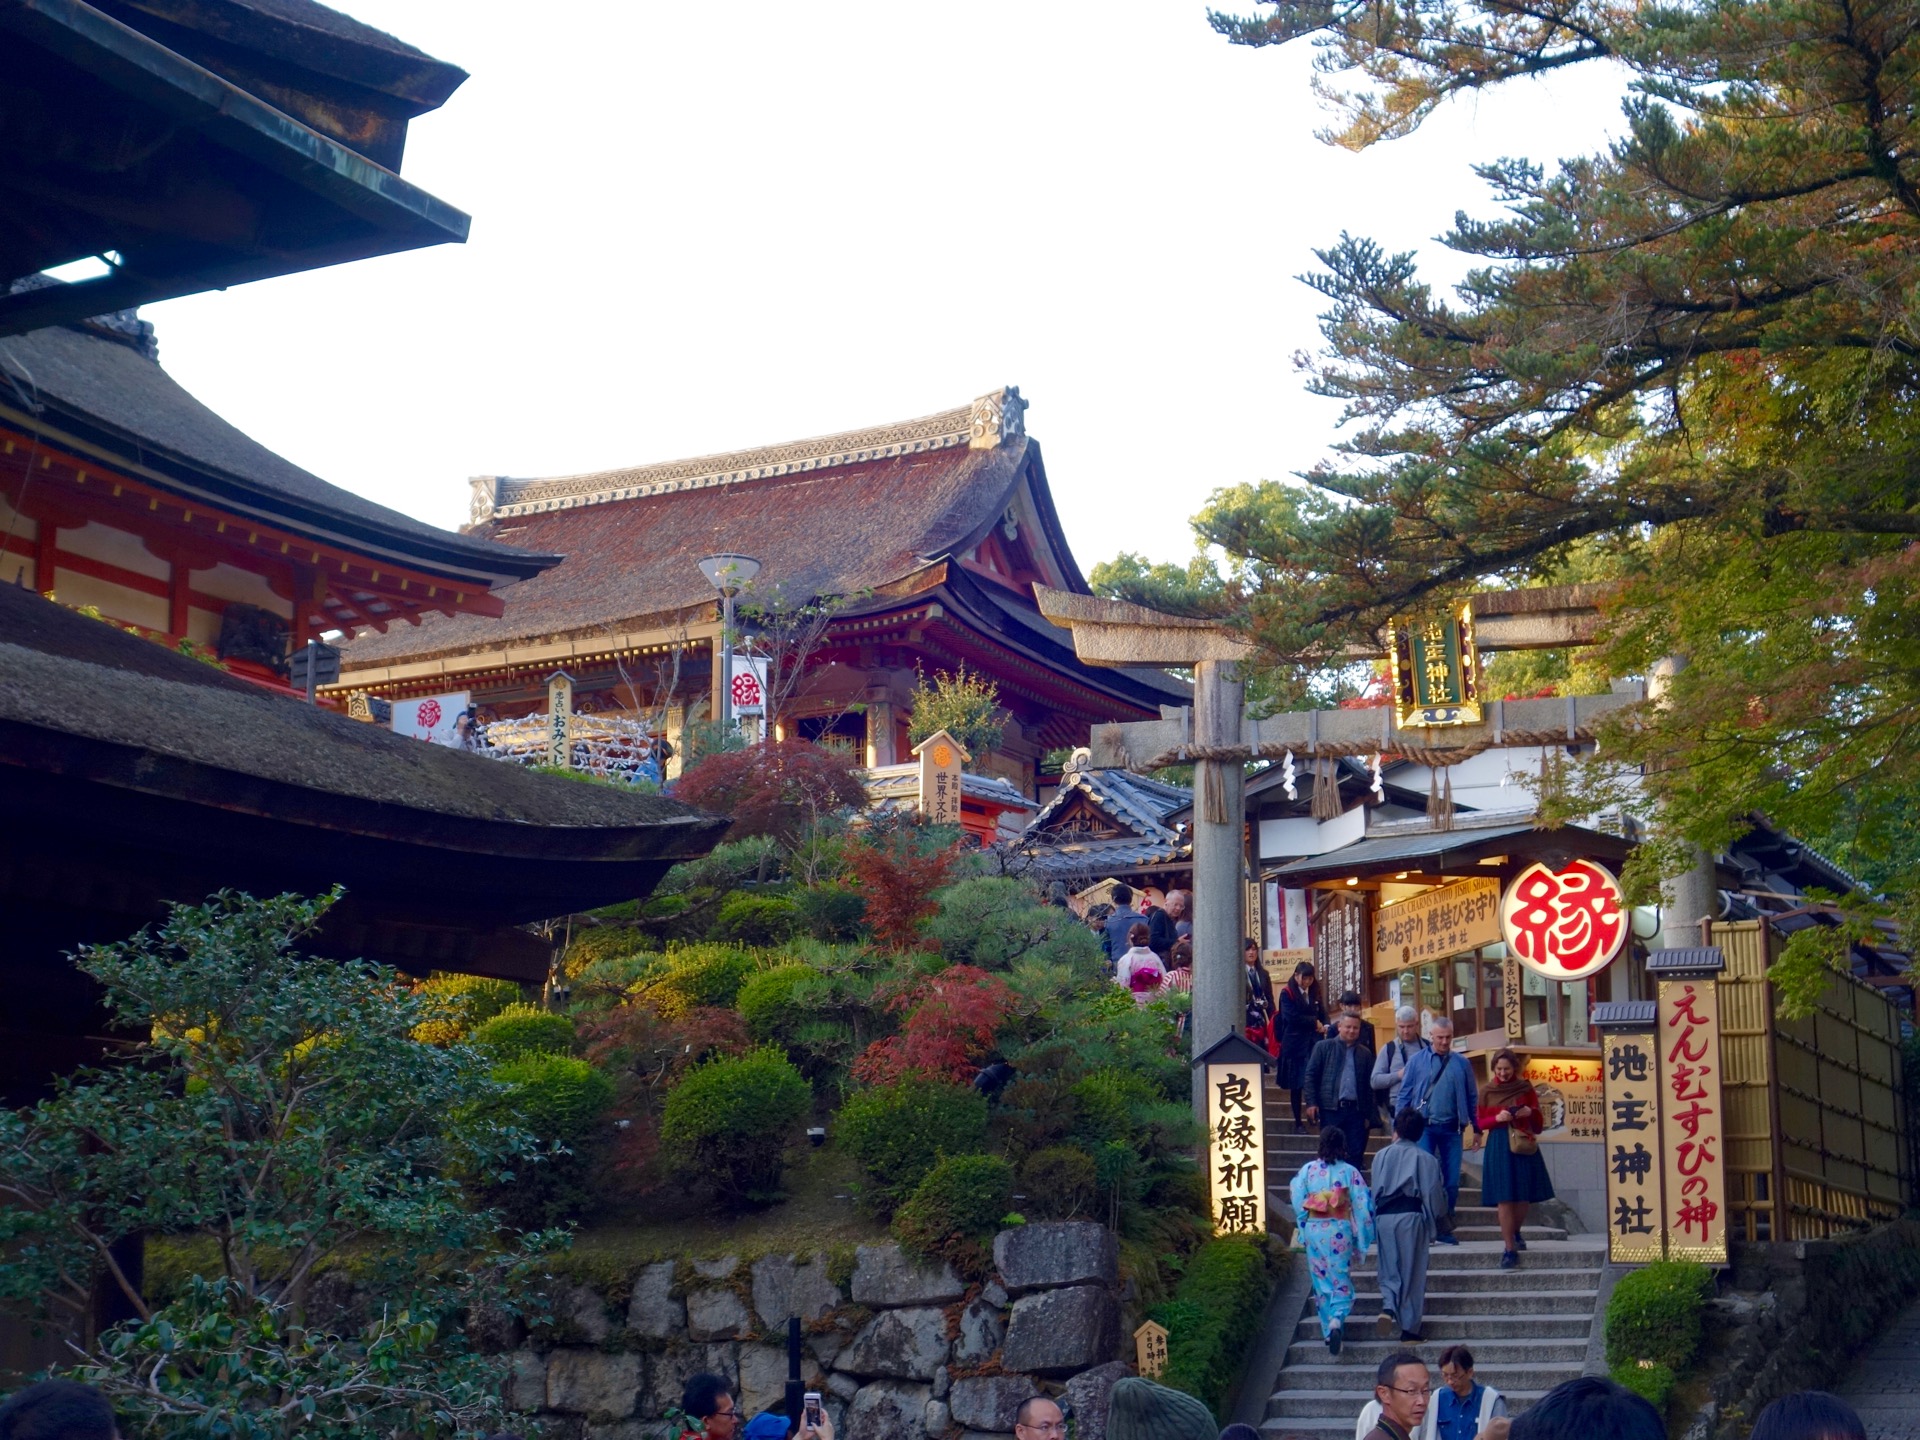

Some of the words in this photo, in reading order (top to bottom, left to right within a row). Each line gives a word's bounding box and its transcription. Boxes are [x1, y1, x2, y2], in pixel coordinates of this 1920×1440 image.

[732, 672, 761, 707] 縁
[1423, 621, 1453, 704] 地主神社
[416, 699, 442, 729] 縁
[552, 690, 567, 767] 恋占いおみくじ
[1376, 913, 1424, 953] 恋のお守り
[1426, 888, 1497, 937] 縁結びお守り
[1391, 903, 1407, 919] LUCK
[1407, 893, 1433, 914] CHARMS
[1433, 887, 1453, 905] KYOTO
[1426, 928, 1469, 955] 地主神社
[1510, 860, 1620, 971] 縁
[1505, 958, 1520, 1035] 恋占いおみくじ
[1568, 1101, 1586, 1115] LOVE
[1608, 1043, 1656, 1236] 地主神社
[1668, 984, 1719, 1243] えんむすびの神
[1215, 1073, 1260, 1233] 良縁祈願
